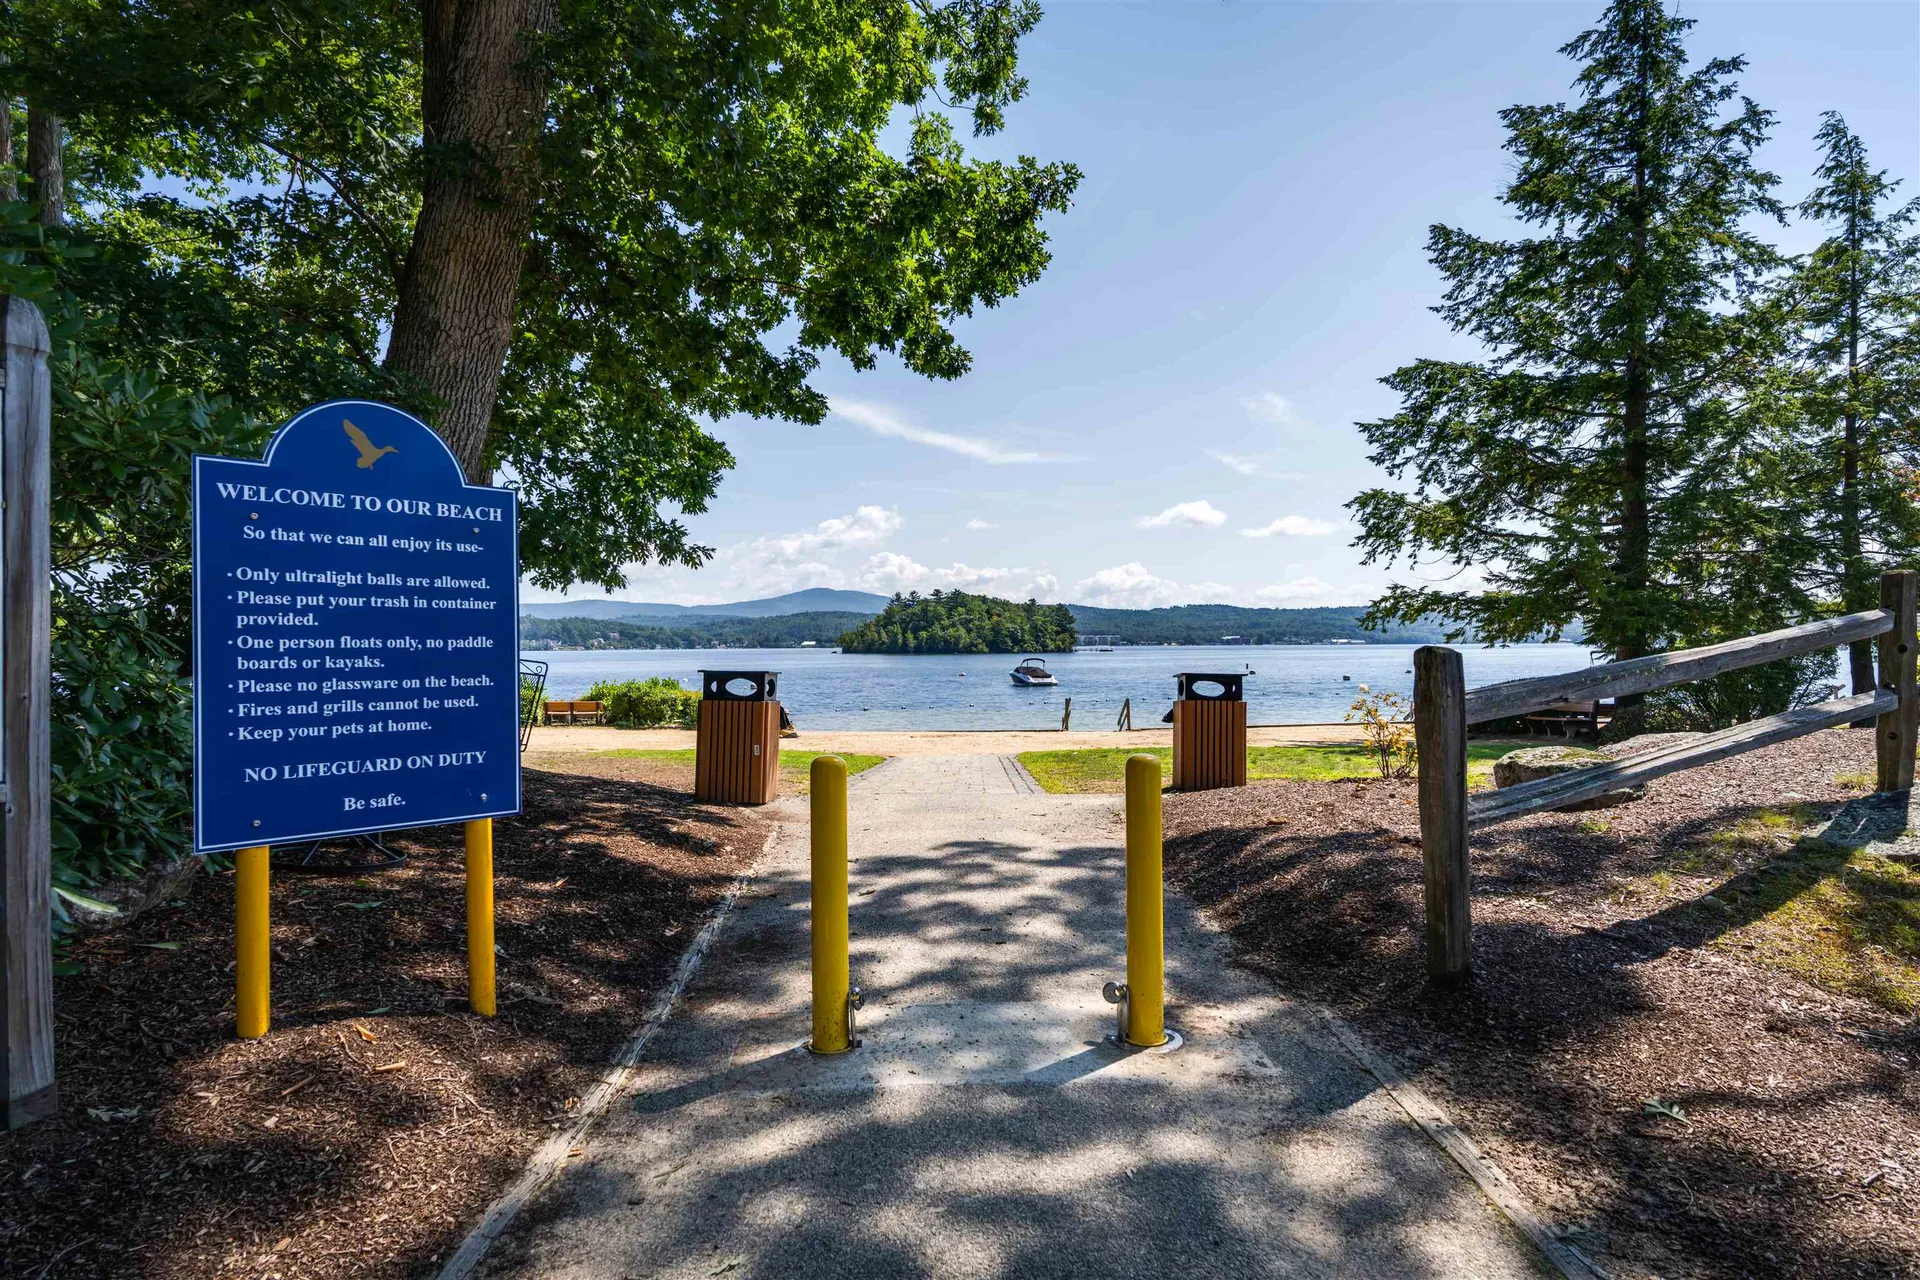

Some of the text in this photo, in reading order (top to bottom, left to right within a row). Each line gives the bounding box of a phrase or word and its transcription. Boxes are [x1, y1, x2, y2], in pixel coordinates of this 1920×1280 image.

[216, 482, 502, 522] WELCOME TO OUR BEACH
[243, 525, 266, 540] So
[270, 527, 305, 542] that
[309, 533, 333, 544] we
[336, 535, 365, 546] can
[368, 534, 388, 547] all
[391, 536, 432, 553] enjoy
[436, 538, 453, 552] its
[236, 566, 490, 589] Only ultralight balls are allowed.
[237, 590, 497, 610] Please put your trash in container
[236, 612, 319, 629] provided.
[236, 635, 494, 652] One person floats only, no paddle
[237, 655, 385, 672] boards or kayaks.
[238, 674, 494, 694] Please no glassware on the beach.
[238, 695, 479, 717] Fires and grills cannot be used.
[238, 719, 432, 742] Keep your pets at home.
[244, 750, 487, 783] NO LIFEGUARD ON DUTY
[344, 793, 406, 811] Be safe.
